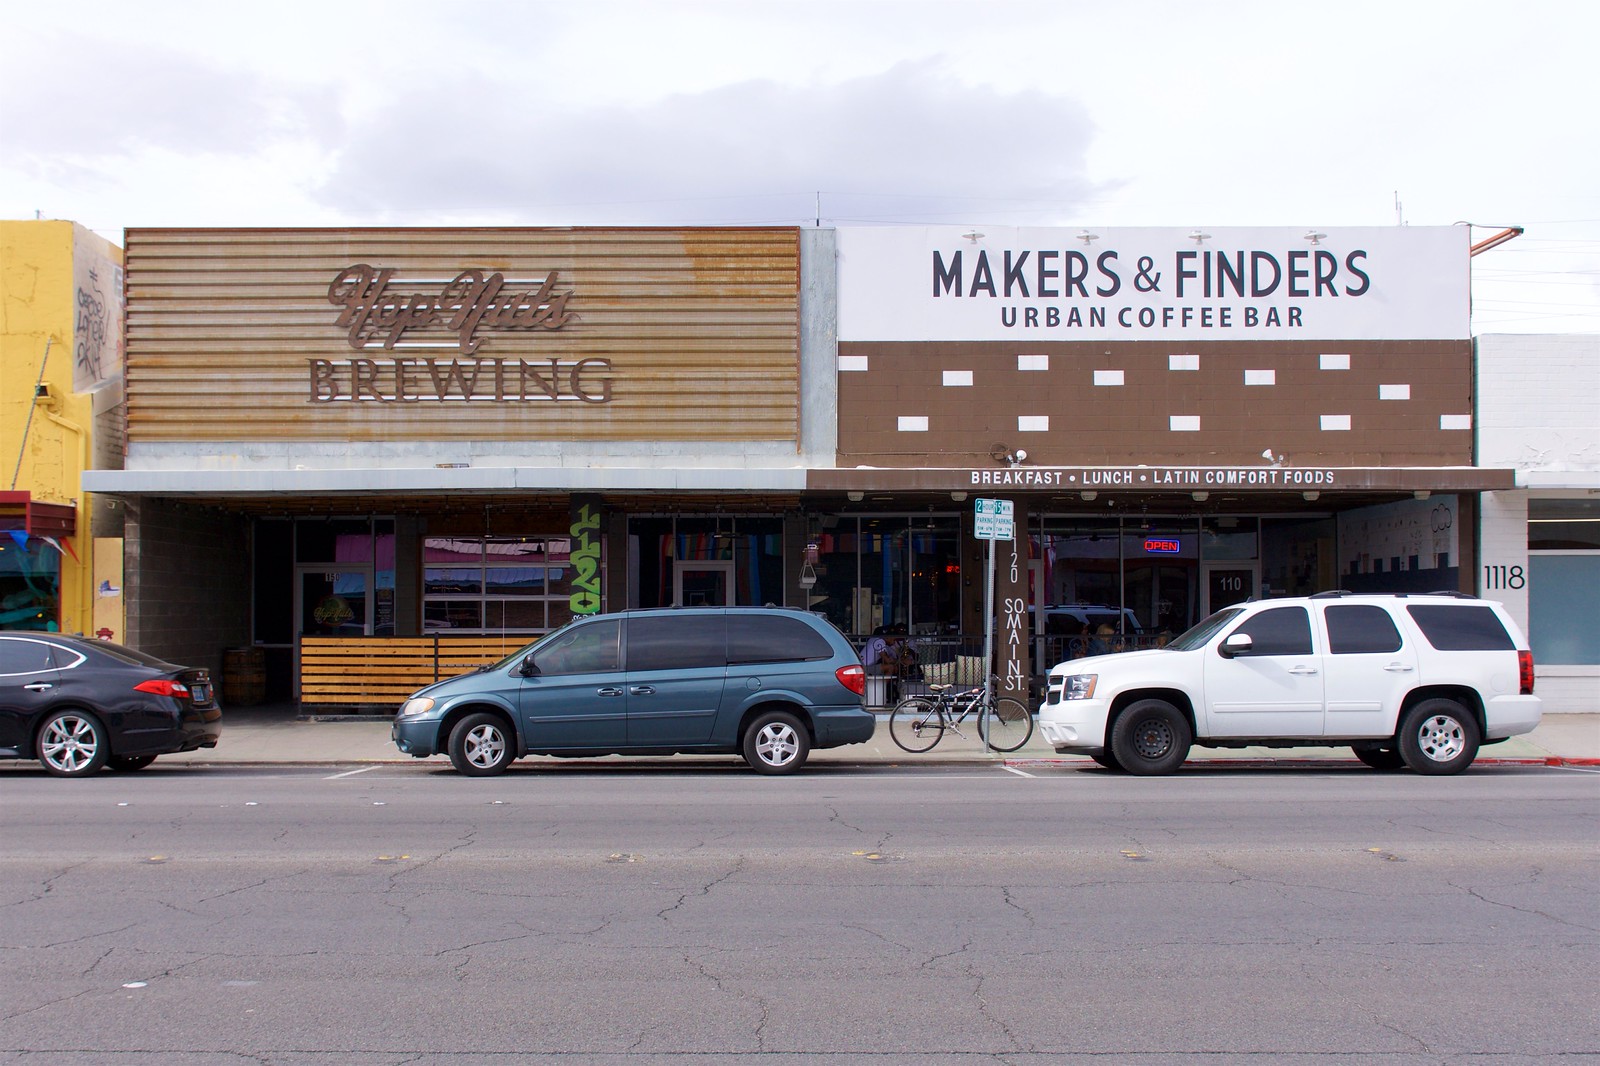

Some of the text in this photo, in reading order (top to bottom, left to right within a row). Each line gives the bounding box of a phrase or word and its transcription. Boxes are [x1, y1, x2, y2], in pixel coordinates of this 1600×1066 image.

[933, 249, 1370, 298] MAKERS & FINDERS
[1001, 306, 1303, 328] URBAN COFFEE BAR
[305, 356, 612, 404] BREWING
[971, 470, 1334, 485] BREAKFAST LUNCH LATIN COMFORT FOODS
[977, 500, 982, 512] 2
[995, 502, 1002, 514] 15
[1144, 541, 1177, 551] OPEN
[570, 504, 600, 614] 1120
[326, 573, 341, 582] 150
[1220, 577, 1241, 591] 110
[1484, 565, 1526, 590] 1118
[1004, 598, 1026, 614] SO.
[1006, 614, 1022, 675] MAIN
[1005, 675, 1025, 691] ST.
